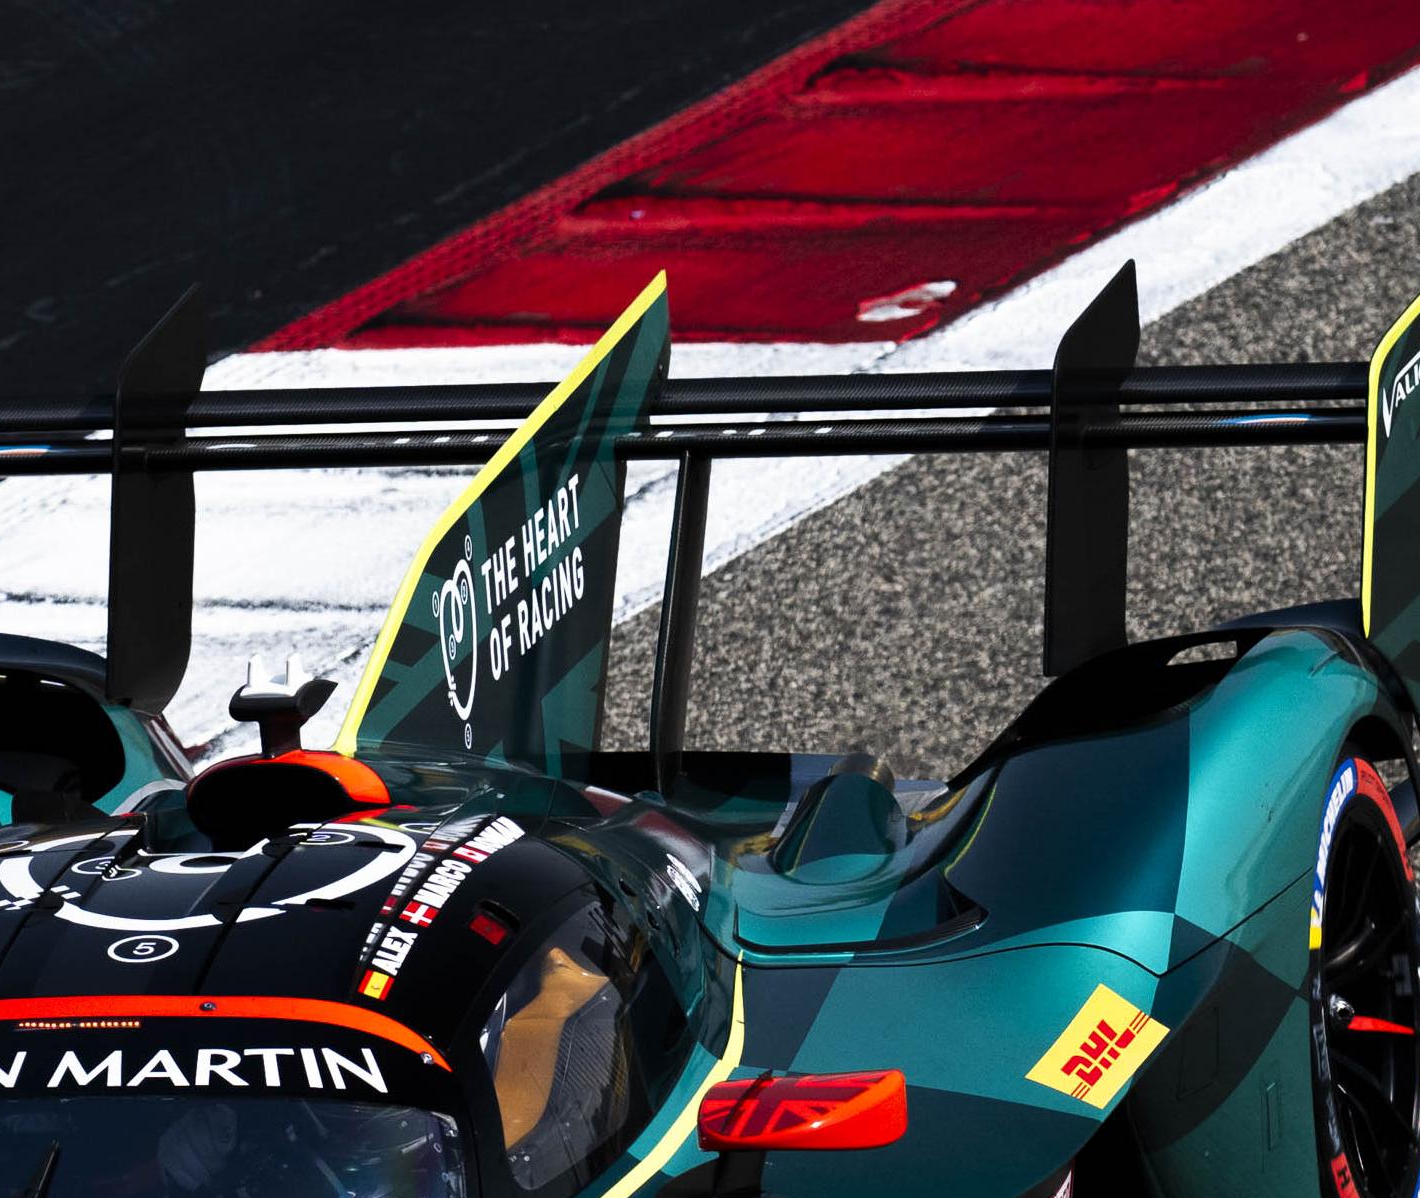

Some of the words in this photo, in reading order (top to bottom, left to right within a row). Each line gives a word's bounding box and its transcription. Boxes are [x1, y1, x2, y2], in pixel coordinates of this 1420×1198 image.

[481, 536, 519, 615] THE
[522, 473, 580, 578] HEART
[490, 614, 512, 681] OF
[518, 546, 584, 655] RACING
[1316, 767, 1354, 889] MICHELIN
[132, 942, 157, 955] 5
[371, 926, 418, 976] ALEX
[412, 859, 472, 908] MARCO
[47, 1047, 388, 1093] MARTIN
[1060, 1019, 1136, 1087] DHL
